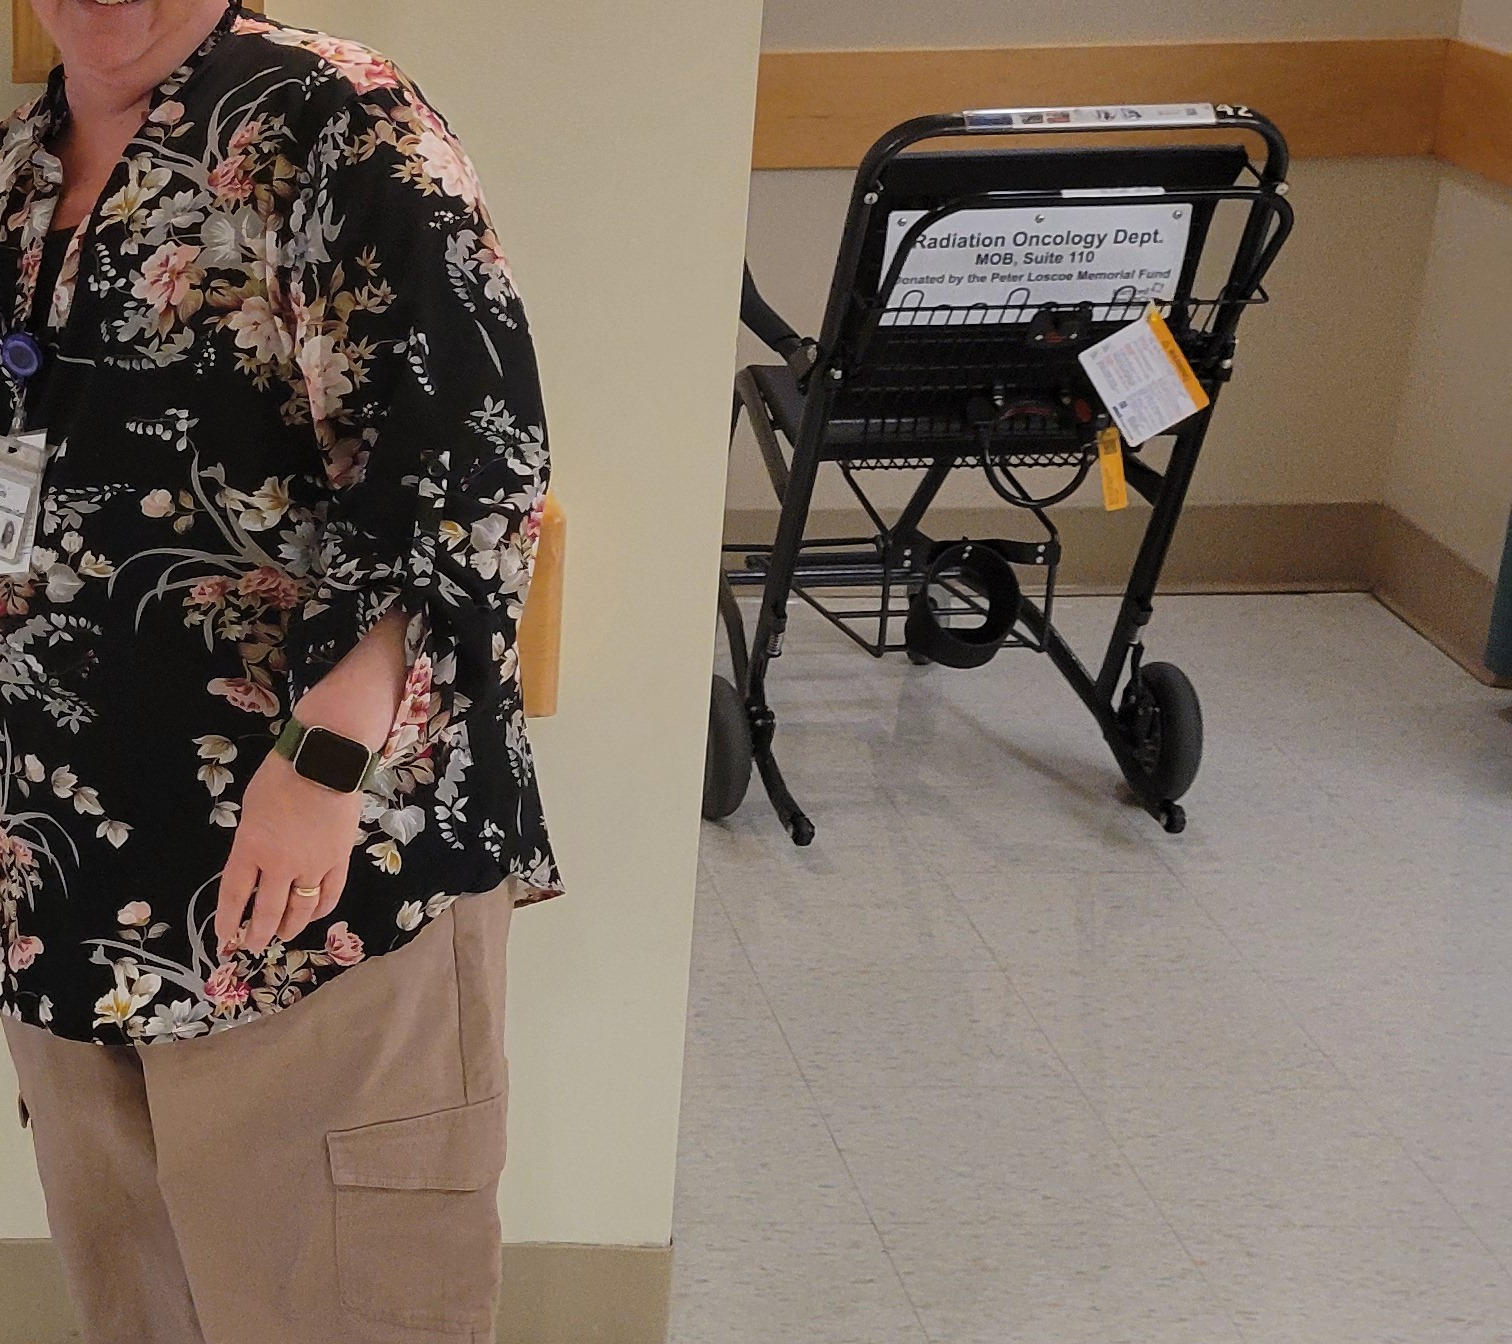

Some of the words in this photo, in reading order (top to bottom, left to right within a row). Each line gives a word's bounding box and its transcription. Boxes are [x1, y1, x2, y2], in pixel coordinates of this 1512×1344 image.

[913, 232, 1006, 250] Radiation
[1013, 229, 1108, 249] Oncology
[1113, 228, 1164, 247] Dept.
[974, 252, 1018, 266] MOB,
[1023, 250, 1064, 265] Suite
[1070, 250, 1095, 263] 110
[948, 273, 964, 286] by
[967, 273, 988, 284] the
[990, 271, 1025, 283] Peter
[1076, 268, 1137, 281] Memorial
[1138, 268, 1172, 280] Fund
